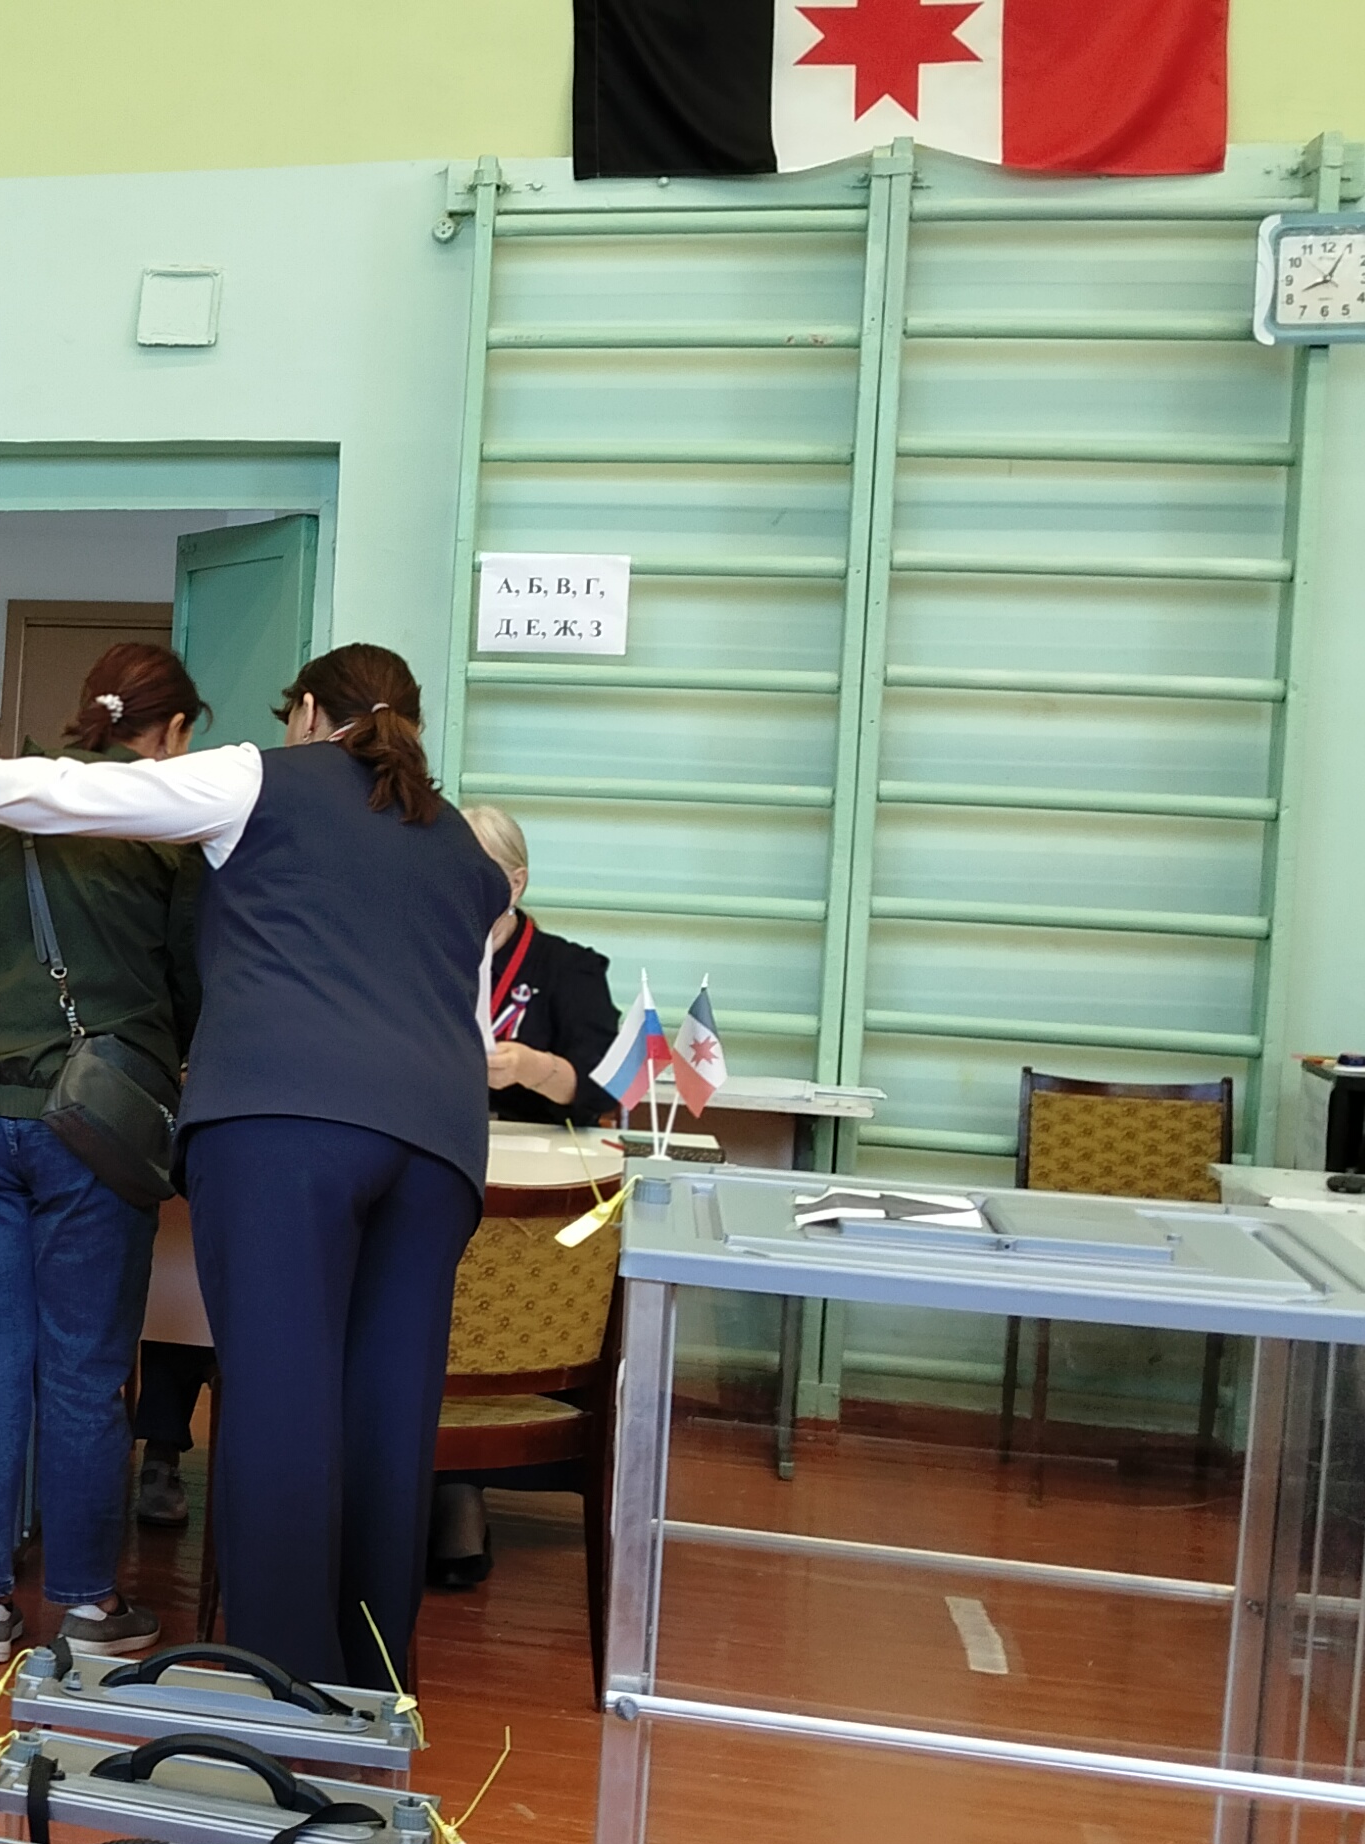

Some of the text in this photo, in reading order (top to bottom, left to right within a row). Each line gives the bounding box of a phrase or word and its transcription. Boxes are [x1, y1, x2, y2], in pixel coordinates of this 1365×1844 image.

[1301, 243, 1313, 255] 11
[1321, 242, 1336, 253] 12
[1288, 257, 1302, 268] 10
[1284, 275, 1294, 287] 9
[1285, 293, 1294, 305] 8
[1299, 305, 1308, 319] 7
[1320, 305, 1329, 317] 6
[1341, 304, 1350, 316] 5
[497, 577, 605, 599] А, Б, В, Г,
[494, 618, 602, 639] Д, Е, Ж, З
